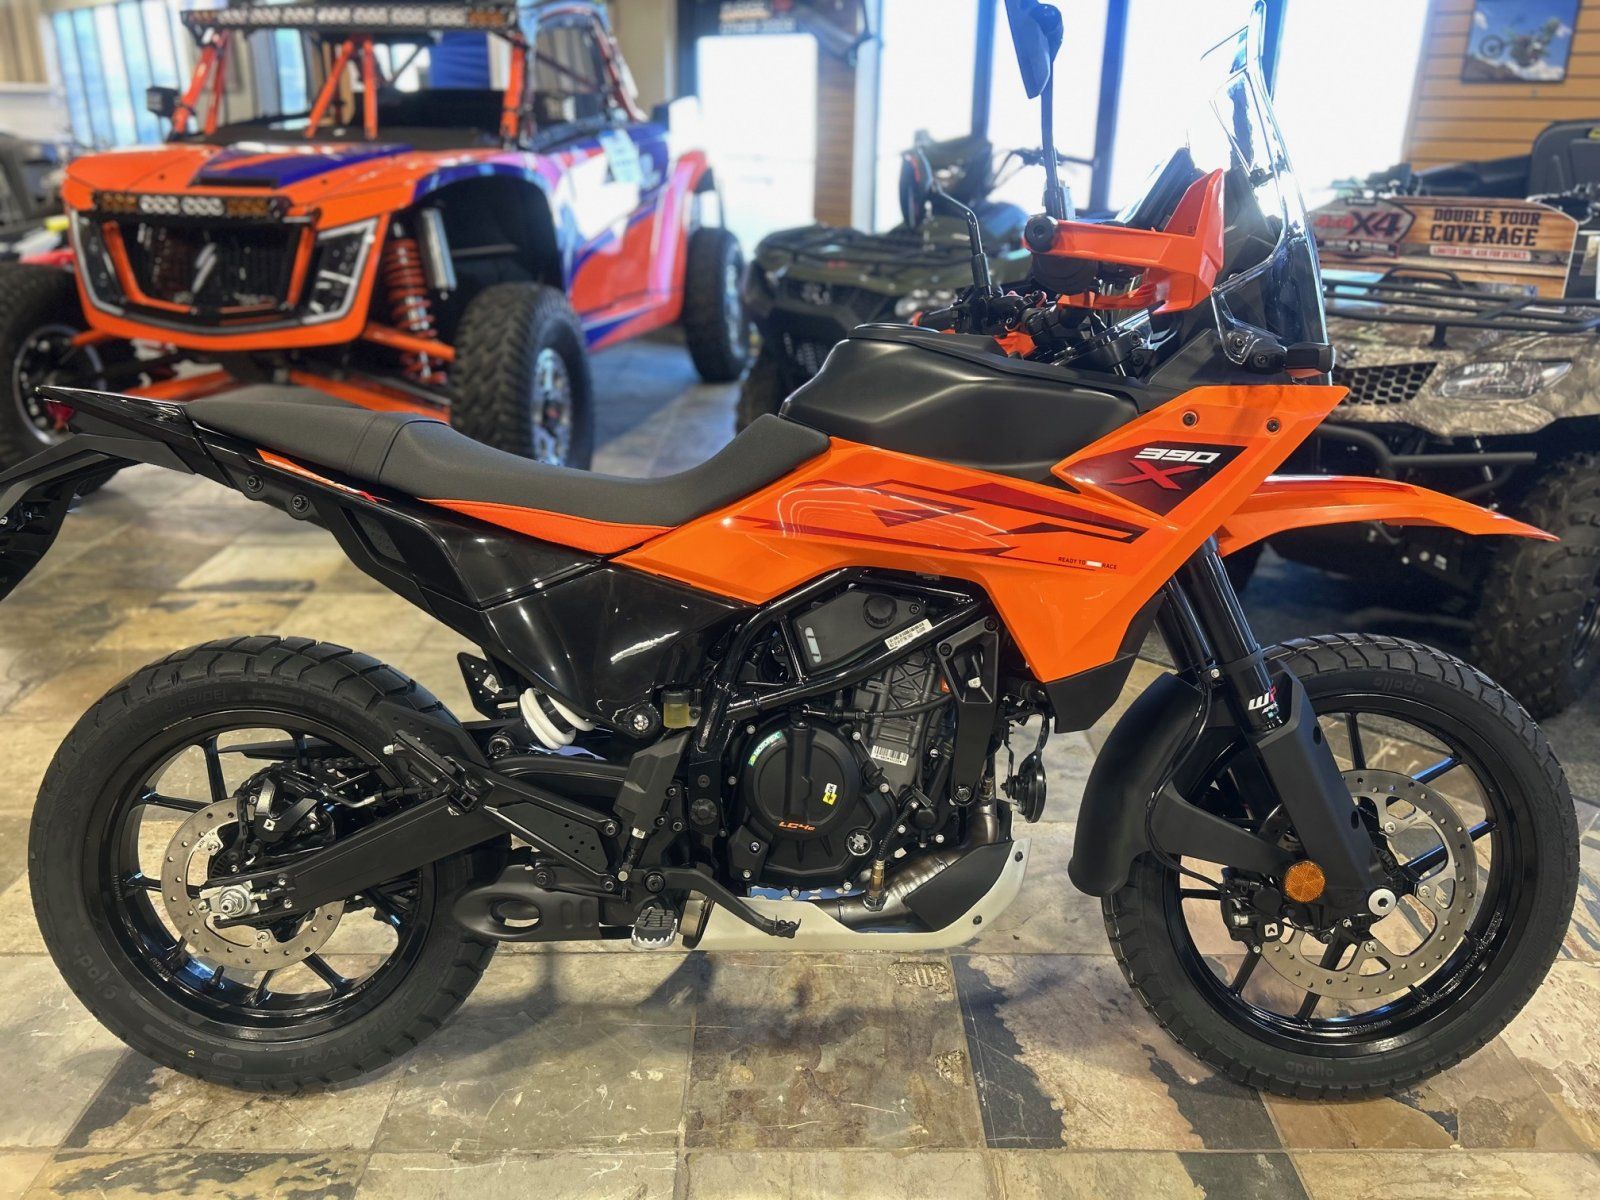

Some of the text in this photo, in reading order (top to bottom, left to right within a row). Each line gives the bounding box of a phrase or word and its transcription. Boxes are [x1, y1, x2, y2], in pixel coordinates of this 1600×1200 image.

[1433, 207, 1542, 226] DOUBLE YOUR
[1429, 224, 1539, 247] COVERAGE
[1134, 447, 1222, 464] 390
[1105, 459, 1204, 490] X
[1058, 556, 1077, 565] READY
[1101, 562, 1118, 570] RACE
[1284, 1060, 1335, 1078] apollo
